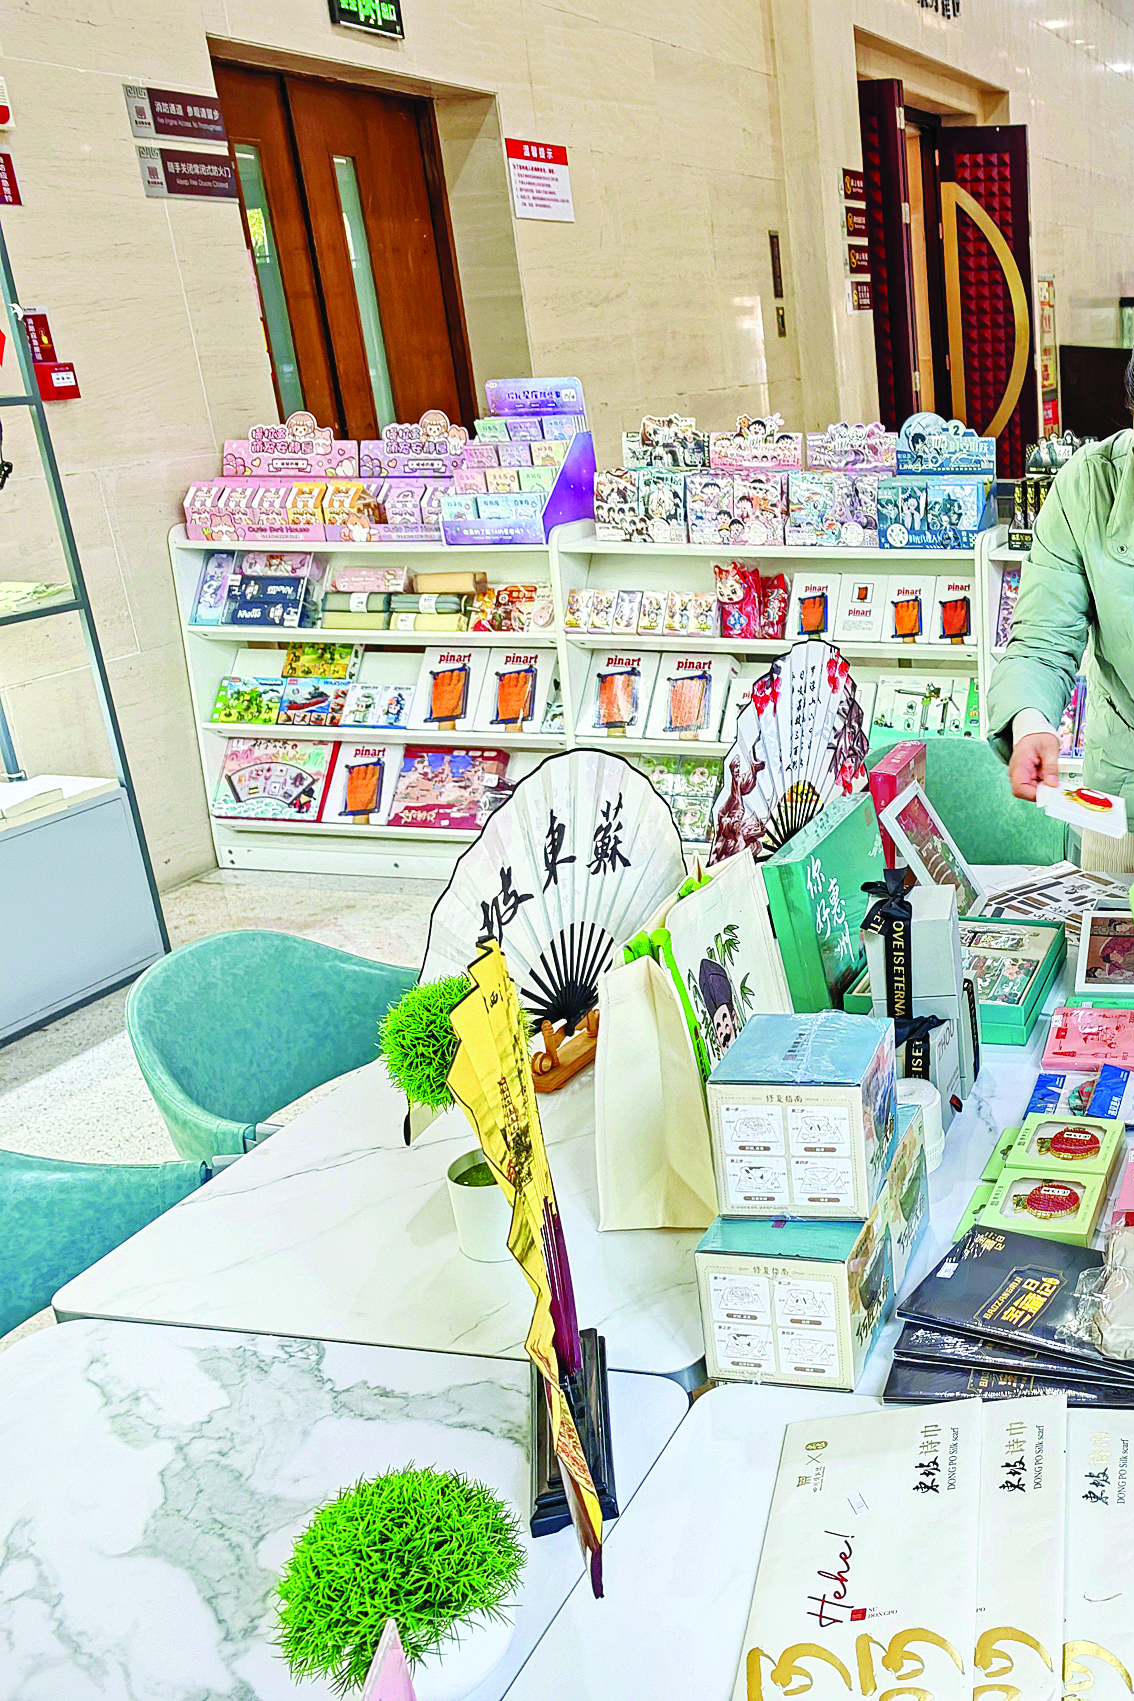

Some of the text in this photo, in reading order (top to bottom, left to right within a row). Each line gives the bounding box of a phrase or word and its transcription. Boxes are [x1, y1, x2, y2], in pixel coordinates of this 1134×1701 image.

[522, 144, 554, 160] 温馨提示
[953, 424, 961, 436] 2
[804, 583, 829, 593] pinart
[897, 587, 922, 597] pinart
[947, 582, 971, 592] pinart
[848, 607, 872, 618] pinart
[438, 652, 472, 664] pinart
[504, 653, 539, 665] pinart
[606, 655, 642, 667] pinart
[676, 658, 713, 671] pinart
[354, 745, 386, 758] pinart
[806, 854, 832, 941] 你好
[827, 877, 855, 963] 惠州
[892, 920, 906, 1019] OVE IS ETERNA
[765, 1094, 803, 1103] 修复指南
[752, 1265, 789, 1276] 修复指南
[1001, 1278, 1058, 1327] 宝藏日记
[946, 1426, 960, 1491] DONG PO Silk scarf
[1032, 1424, 1045, 1490] DONG PO Silk scarf
[1115, 1438, 1130, 1505] DONG PO Silk scarf
[806, 1529, 857, 1629] Hehe!
